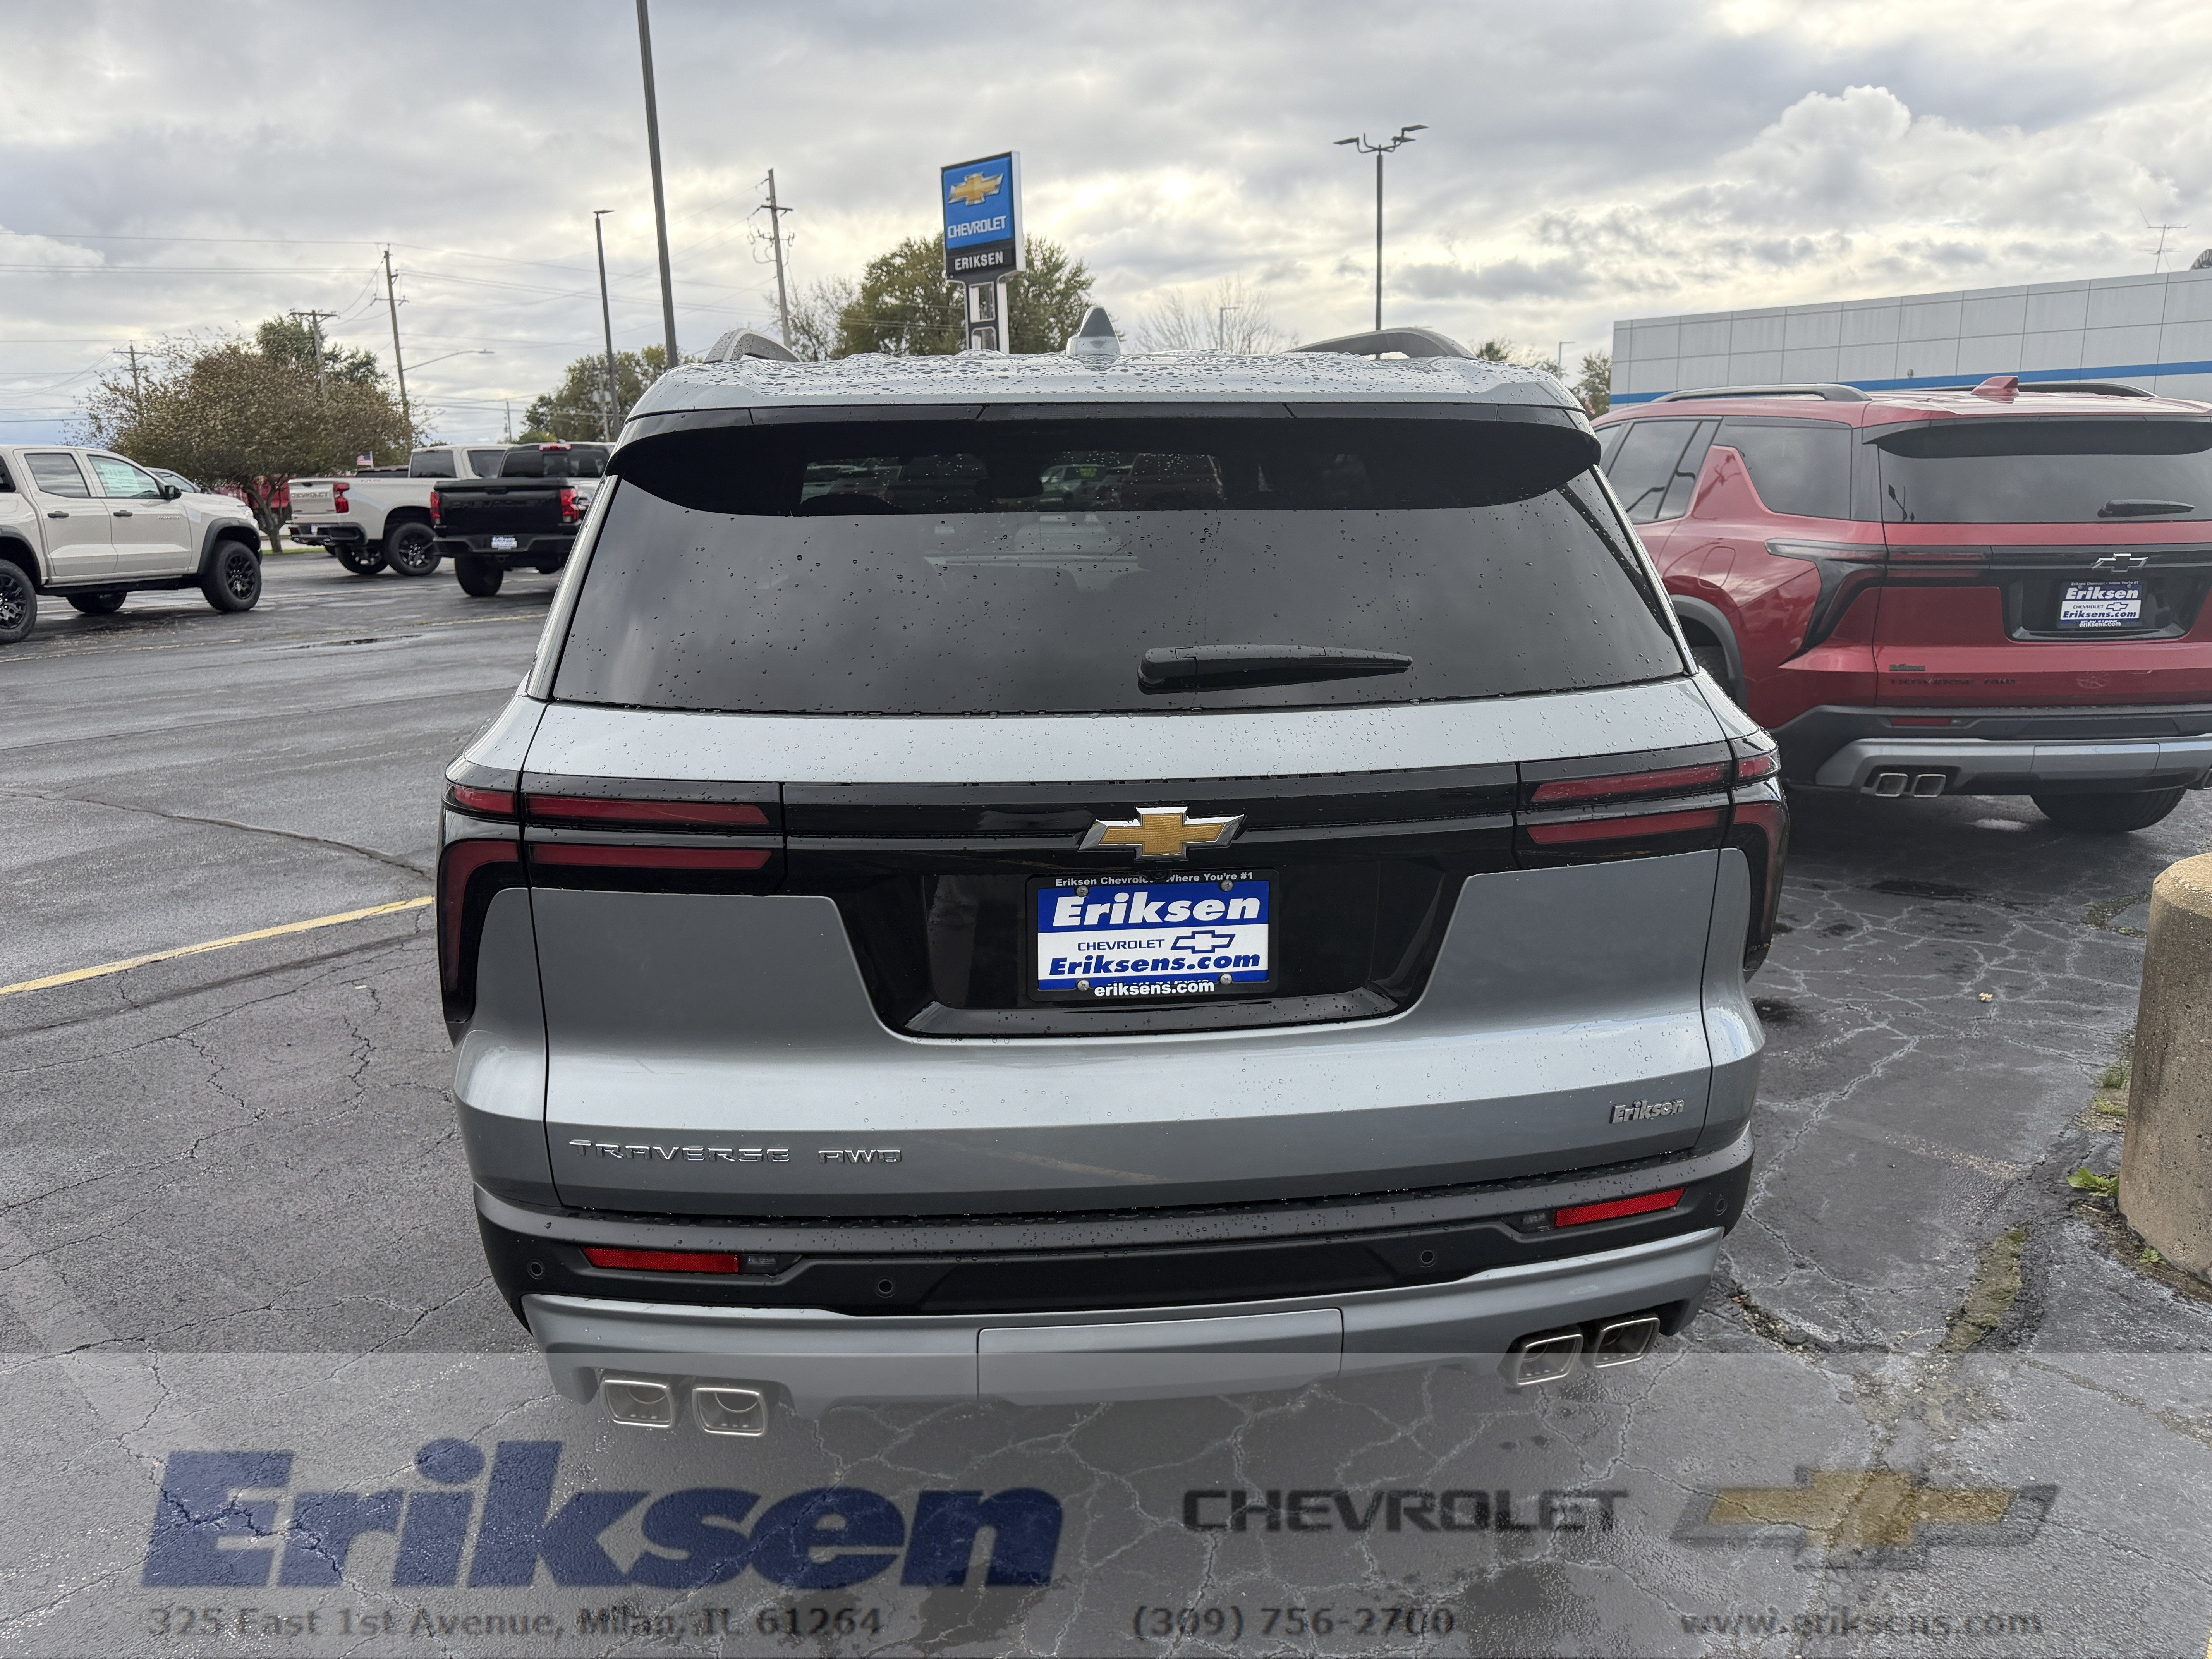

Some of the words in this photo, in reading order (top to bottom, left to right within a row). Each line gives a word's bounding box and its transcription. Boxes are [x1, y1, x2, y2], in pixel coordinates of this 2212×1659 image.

[948, 215, 1007, 239] CHEVROLET
[954, 251, 1003, 271] ERIKSEN
[2065, 586, 2138, 599] Eriksen
[1055, 878, 1097, 887] Eriksen
[1100, 876, 1153, 884] Chevrole
[1204, 872, 1237, 881] You're
[1240, 872, 1253, 880] #1
[1053, 891, 1261, 926] Eriksen
[1077, 939, 1165, 951] CHEVROLET
[1049, 953, 1260, 975] Eriksens.com
[1094, 980, 1214, 997] eriksens.com
[1609, 1098, 1685, 1124] Eriksen
[568, 1139, 789, 1162] TRAVERSE
[818, 1149, 903, 1164] AWD
